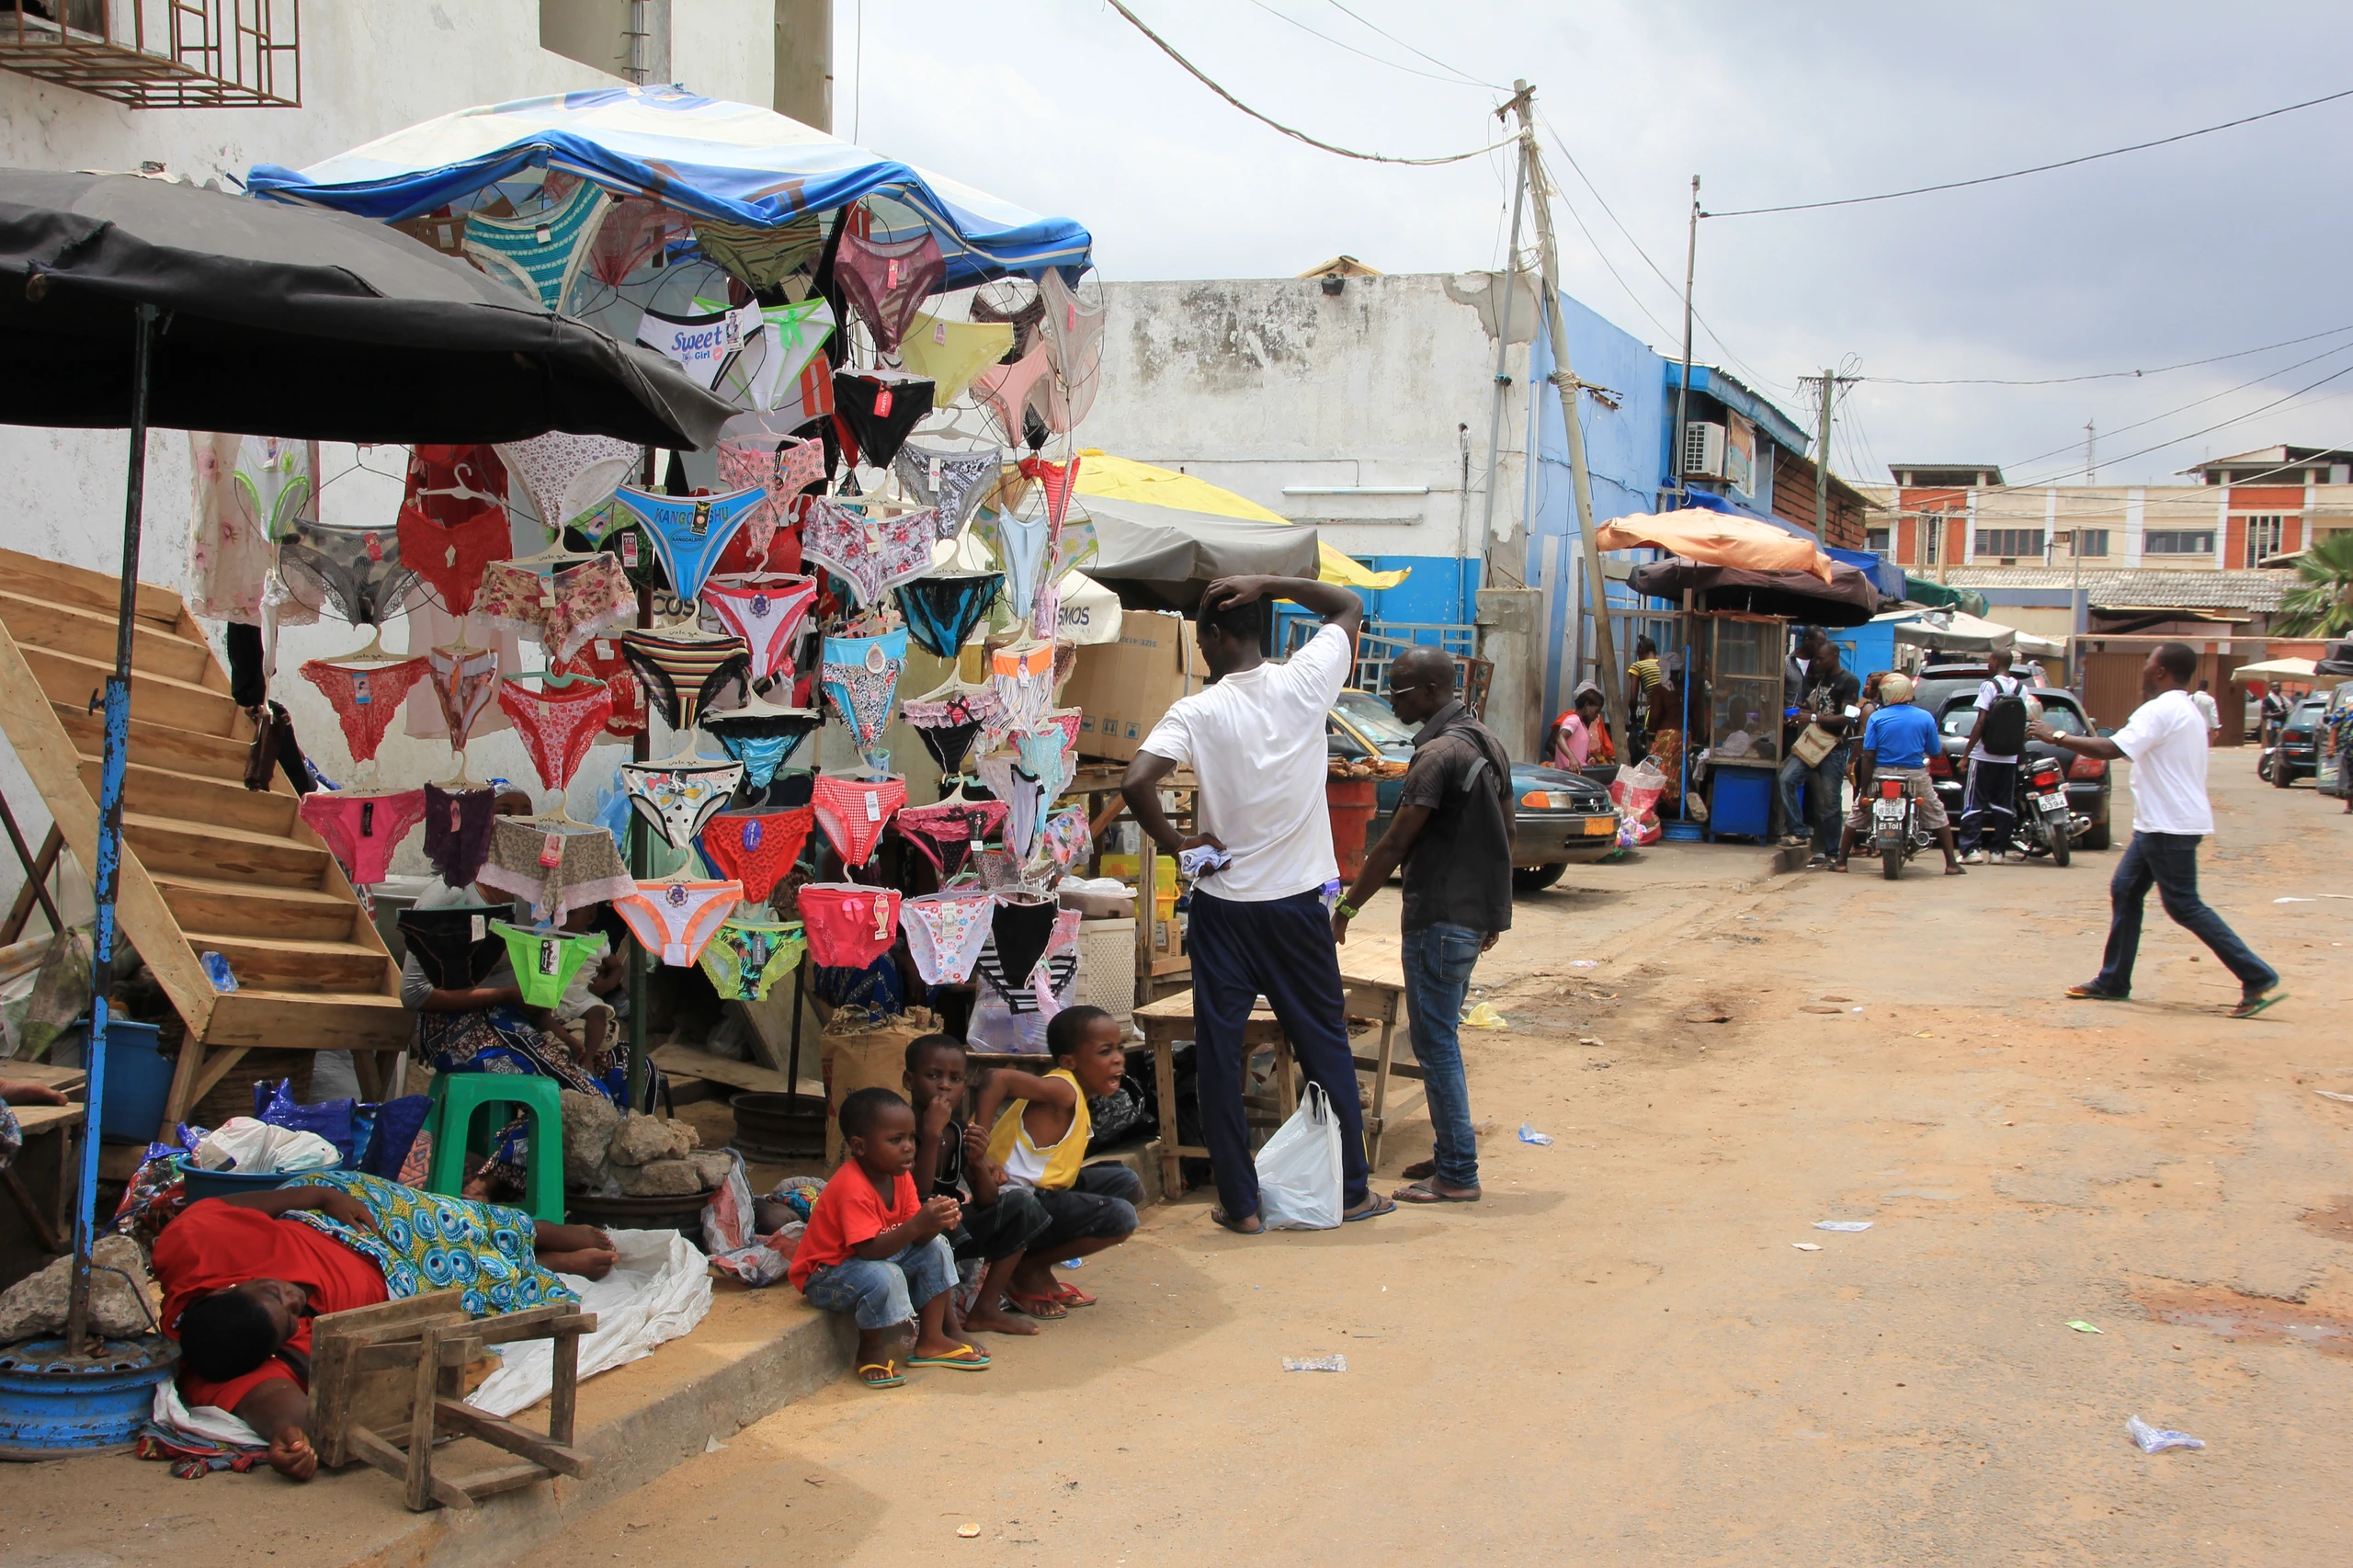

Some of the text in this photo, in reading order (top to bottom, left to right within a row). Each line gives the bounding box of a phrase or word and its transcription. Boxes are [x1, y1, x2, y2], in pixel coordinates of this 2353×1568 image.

[671, 325, 723, 352] Sweet
[694, 349, 710, 360] Girl
[654, 506, 729, 526] KANGOSHU
[2040, 800, 2065, 811] 0394
